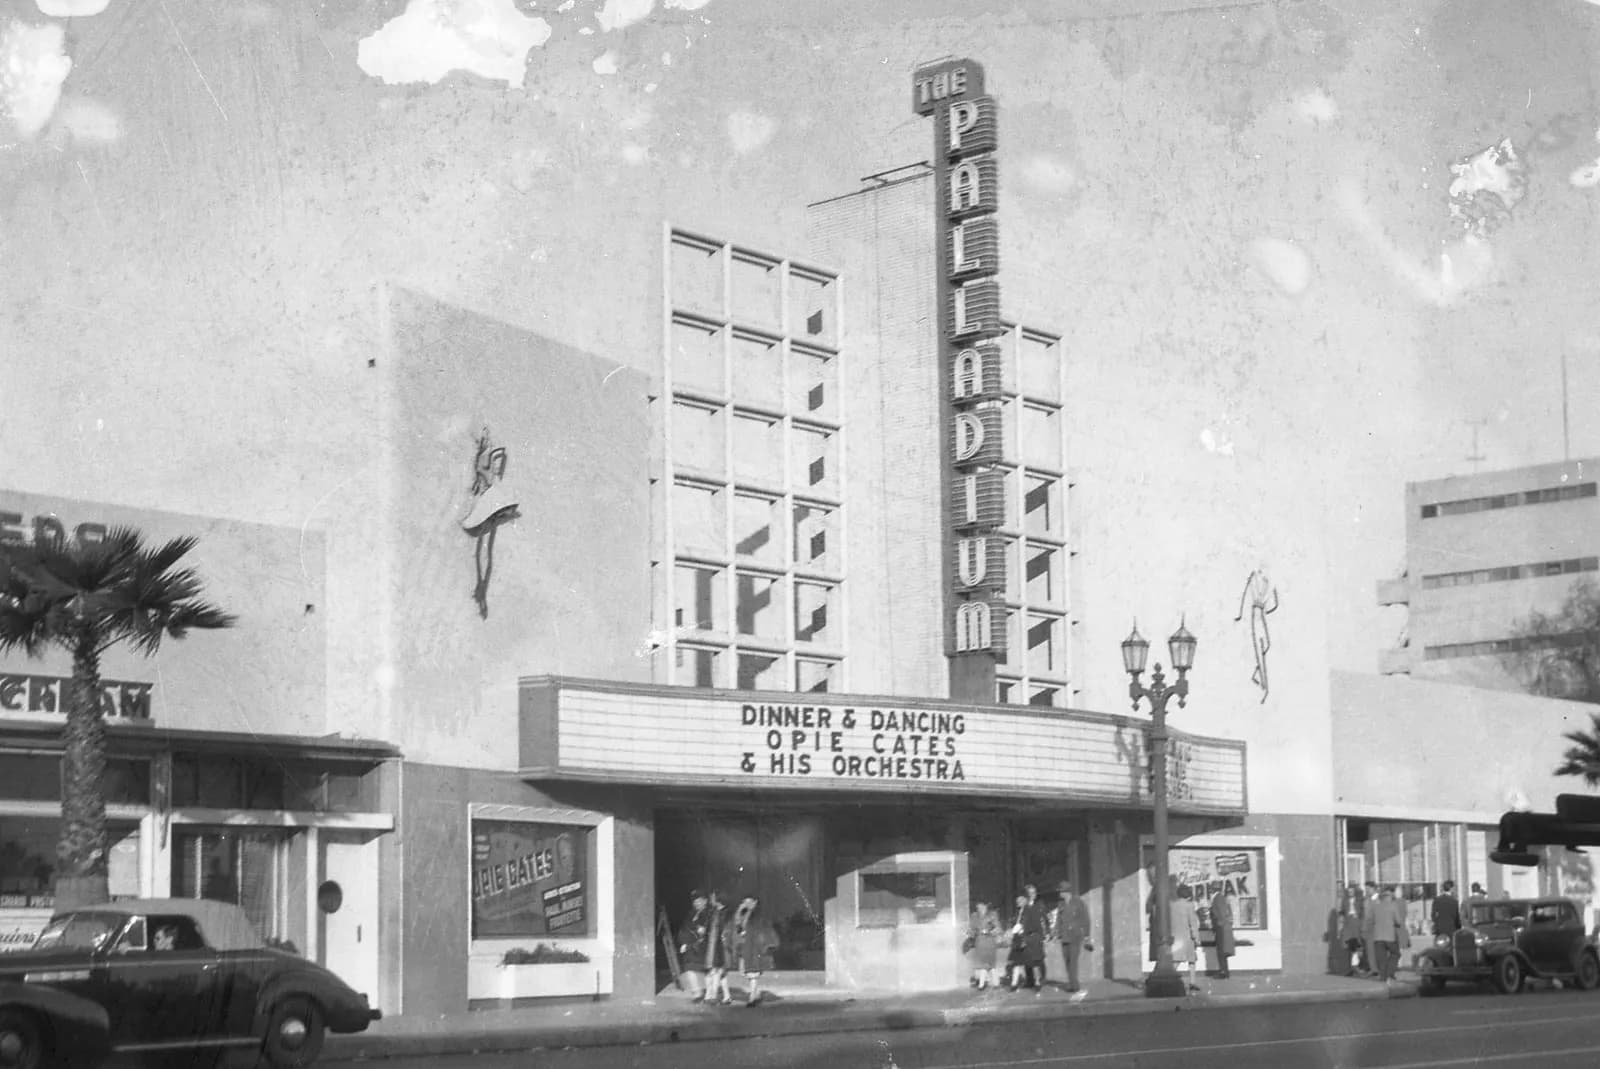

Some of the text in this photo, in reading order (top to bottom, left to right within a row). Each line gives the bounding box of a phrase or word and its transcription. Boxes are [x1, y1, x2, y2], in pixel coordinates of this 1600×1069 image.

[915, 66, 967, 105] THE
[950, 100, 992, 652] PALLADIUM
[0, 675, 152, 719] CRAM
[741, 704, 965, 735] DINNER & DANCING
[766, 729, 956, 757] OPIE CATES
[740, 752, 965, 781] & HIS ORCHESTRA
[506, 849, 553, 890] CATES
